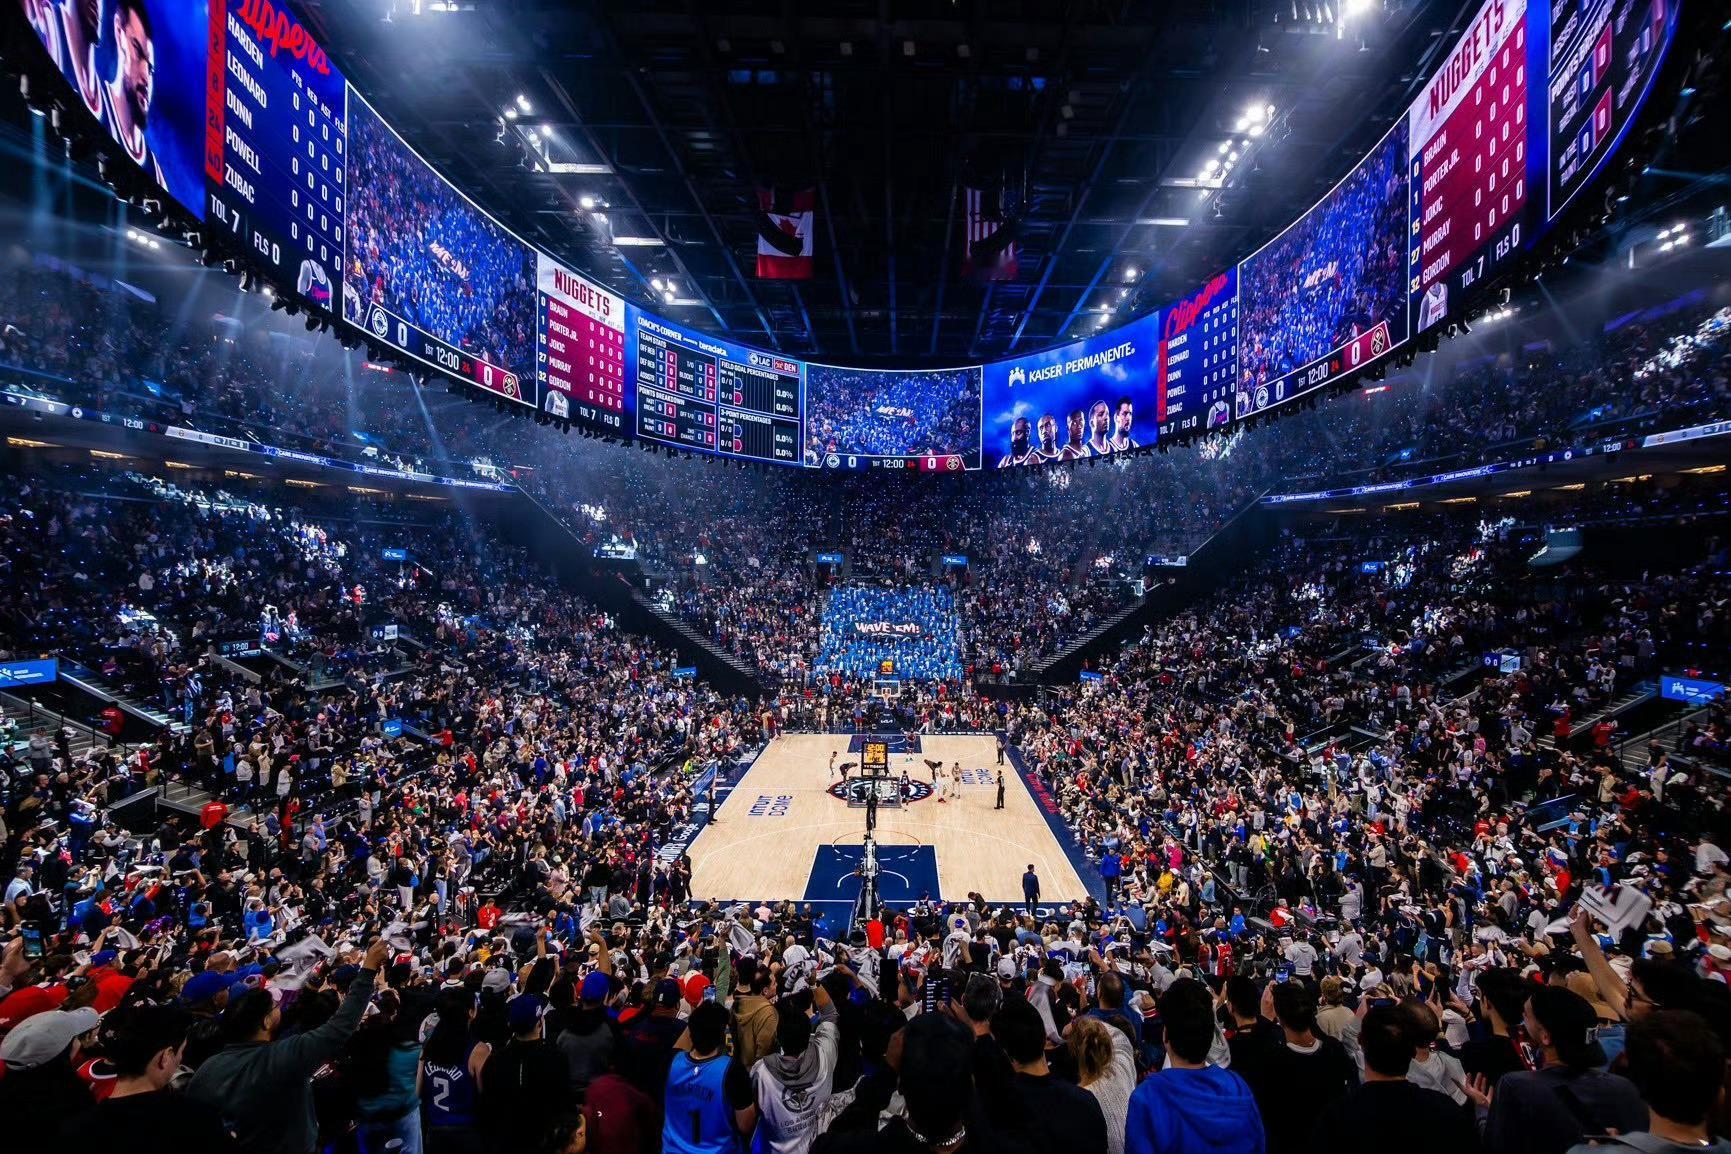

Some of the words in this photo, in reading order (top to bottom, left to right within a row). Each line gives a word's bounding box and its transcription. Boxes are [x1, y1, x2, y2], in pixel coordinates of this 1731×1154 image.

[1430, 0, 1504, 121] NUGGETS
[228, 12, 263, 70] HARDEN
[294, 92, 299, 110] 0
[309, 110, 314, 126] 0
[323, 124, 328, 140] 0
[336, 138, 342, 154] 0
[228, 50, 267, 108] LEONARD
[293, 125, 299, 142] 0
[309, 141, 314, 158] 0
[322, 154, 328, 170] 0
[336, 168, 342, 183] 0
[227, 88, 252, 129] DUNN
[292, 158, 298, 174] 0
[308, 172, 314, 189] 0
[322, 185, 327, 200] 0
[336, 197, 341, 212] 0
[1414, 161, 1419, 177] 0
[1424, 130, 1446, 167] BRAUN
[226, 125, 261, 175] POWELL
[292, 190, 298, 207] 0
[308, 204, 313, 220] 0
[322, 215, 327, 231] 0
[336, 226, 341, 241] 0
[1414, 191, 1419, 205] 1
[1424, 164, 1448, 196] PORTER
[225, 163, 254, 204] ZUBAC
[292, 222, 297, 239] 0
[308, 235, 313, 251] 0
[321, 245, 326, 261] 0
[335, 256, 340, 270] 0
[1412, 218, 1420, 235] 15
[1423, 196, 1442, 226] JOKIC
[211, 194, 228, 224] TOL
[232, 210, 240, 233] 7
[254, 231, 268, 256] FLS
[272, 243, 280, 265] 0
[1411, 246, 1420, 265] 27
[1423, 218, 1450, 255] MURRAY
[1462, 267, 1474, 288] TOL
[1478, 256, 1484, 278] 7
[1496, 236, 1509, 261] FLS
[1512, 223, 1519, 248] 0
[1411, 275, 1420, 293] 32
[1422, 250, 1450, 284] GORDON
[554, 269, 610, 316] NUGGETS
[541, 297, 545, 306] 0
[550, 300, 568, 318] BRAUN
[542, 316, 544, 325] 1
[550, 320, 569, 337] PORTER
[570, 330, 578, 341] JR.
[540, 333, 546, 344] 15
[549, 339, 565, 353] JOKIC
[1168, 334, 1187, 350] HARDEN
[398, 323, 407, 347] 0
[425, 343, 433, 356] 1ST
[436, 346, 459, 370] 12:00
[462, 362, 471, 374] 24
[484, 366, 492, 385] 0
[539, 352, 546, 363] 27
[549, 356, 571, 373] MURRAY
[759, 357, 770, 366] LAC
[1168, 350, 1189, 366] LEONARD
[747, 367, 778, 380] PERCENTAGES
[784, 363, 796, 372] DEN
[1029, 365, 1062, 383] KAISER
[1168, 370, 1181, 382] DUNN
[1276, 380, 1283, 400] 0
[1308, 362, 1328, 385] 12:00
[1331, 360, 1339, 372] 24
[1352, 342, 1360, 365] 0
[539, 370, 546, 382] 32
[549, 375, 571, 391] GORDON
[639, 386, 655, 397] POINTS
[656, 392, 684, 405] BREAKDOWN
[776, 390, 793, 399] 0.0%
[1167, 385, 1186, 398] POWELL
[580, 406, 589, 418] TOL
[591, 410, 596, 420] 7
[604, 412, 613, 425] FLS
[615, 416, 619, 427] 0
[740, 412, 771, 424] PERCENTAGES
[776, 404, 793, 412] 0.0%
[1167, 402, 1182, 415] ZUBAC
[123, 418, 143, 429] 12:00
[1170, 422, 1174, 433] 7
[1182, 420, 1190, 429] FLS
[1192, 416, 1196, 427] 0
[776, 435, 792, 444] 0.0%
[1604, 443, 1621, 452] 12:00
[776, 449, 792, 458] 0.0%
[848, 457, 856, 467] 0
[883, 459, 904, 468] 12:00
[928, 458, 936, 468] 0
[855, 622, 890, 633] WAVE
[433, 1076, 449, 1112] 2
[688, 1110, 700, 1144] 1
